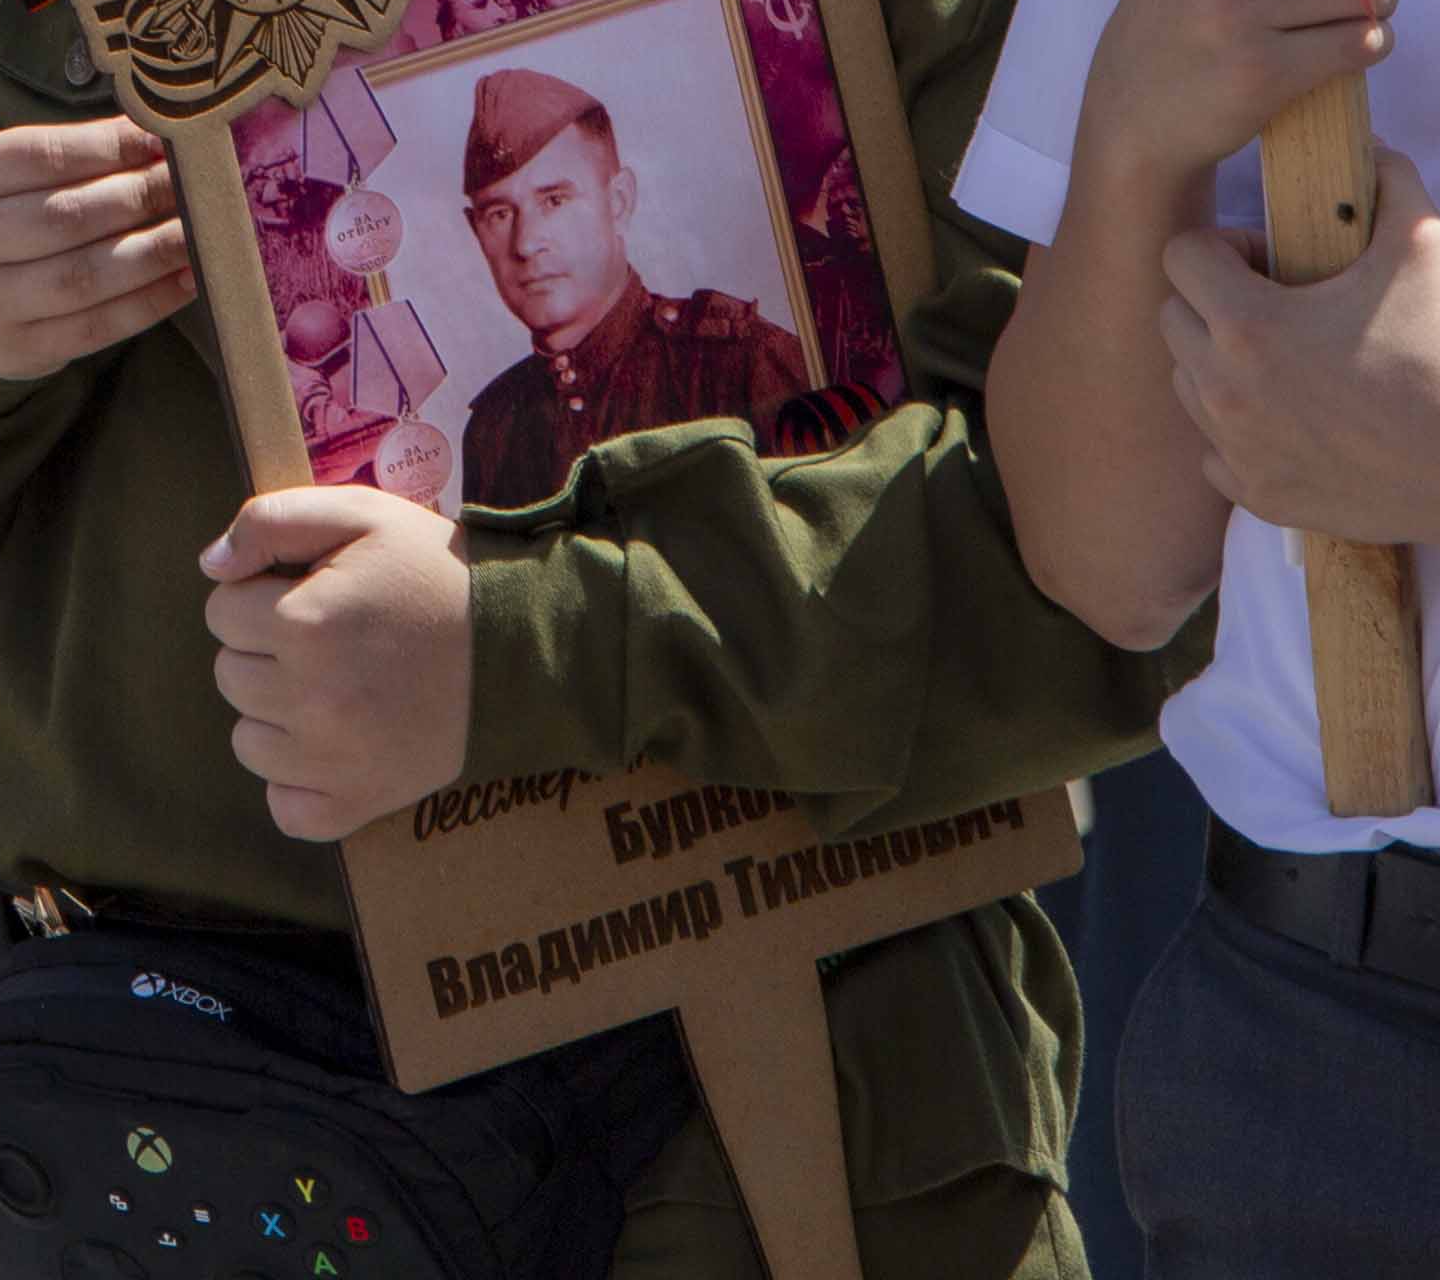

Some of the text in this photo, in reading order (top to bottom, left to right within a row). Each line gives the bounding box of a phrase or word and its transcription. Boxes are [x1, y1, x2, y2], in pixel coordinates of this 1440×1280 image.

[425, 796, 1026, 1021] Владимир Тихонович
[161, 981, 233, 1022] XBOX
[294, 1177, 316, 1204] Y
[259, 1211, 287, 1238] X
[346, 1214, 370, 1242] B
[313, 1250, 338, 1276] A
